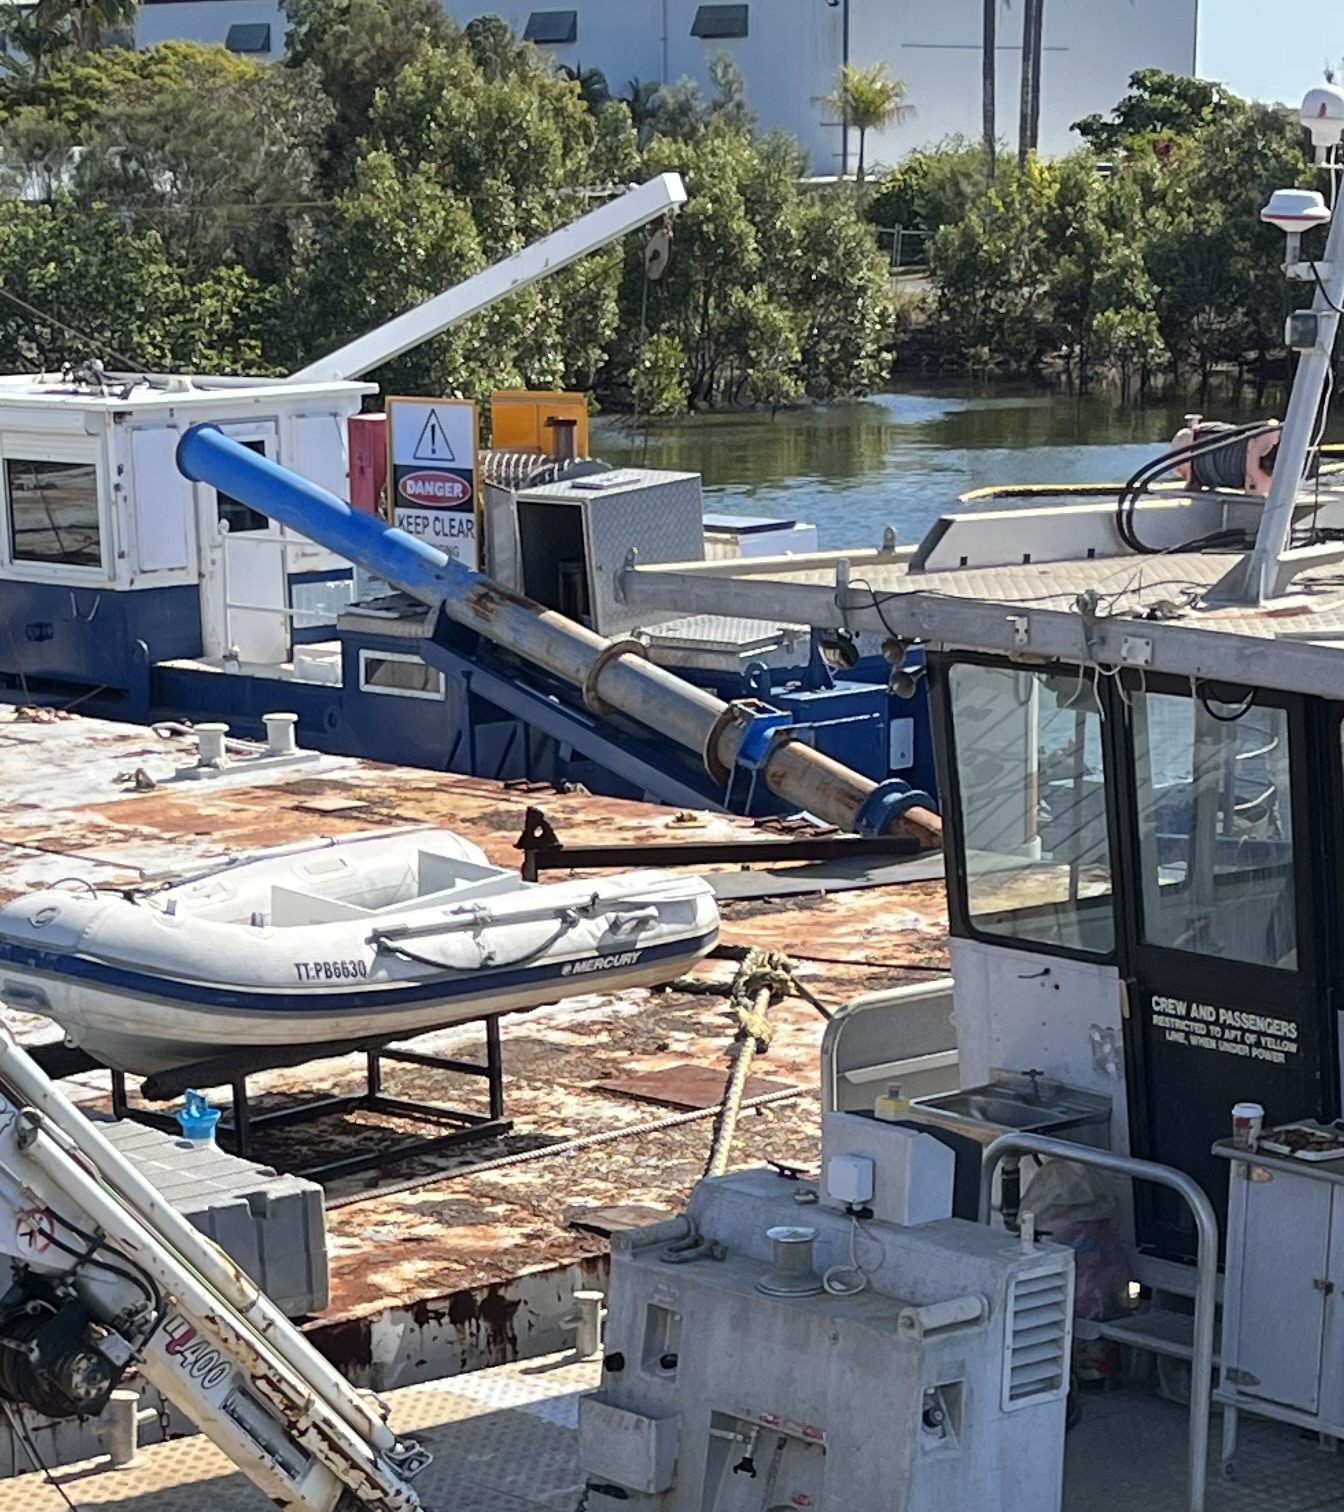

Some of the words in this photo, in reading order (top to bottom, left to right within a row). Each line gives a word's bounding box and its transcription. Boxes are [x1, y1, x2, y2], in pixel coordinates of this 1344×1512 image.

[406, 480, 463, 498] DANGER
[398, 514, 429, 535] KEEP
[433, 516, 475, 538] CLEAR
[572, 951, 642, 974] MERCURY
[1151, 995, 1187, 1016] CREW
[1190, 1003, 1216, 1022] AND
[1219, 1008, 1297, 1039] PASSENGERS
[1152, 1014, 1207, 1035] RESTRICTED
[1208, 1025, 1222, 1037] TO
[1223, 1028, 1242, 1042] AFT
[1243, 1032, 1258, 1045] OF
[1260, 1035, 1298, 1053] YELLOW
[1189, 1034, 1216, 1049] WHEN
[1217, 1040, 1250, 1057] UNDER
[1251, 1046, 1286, 1064] POWER
